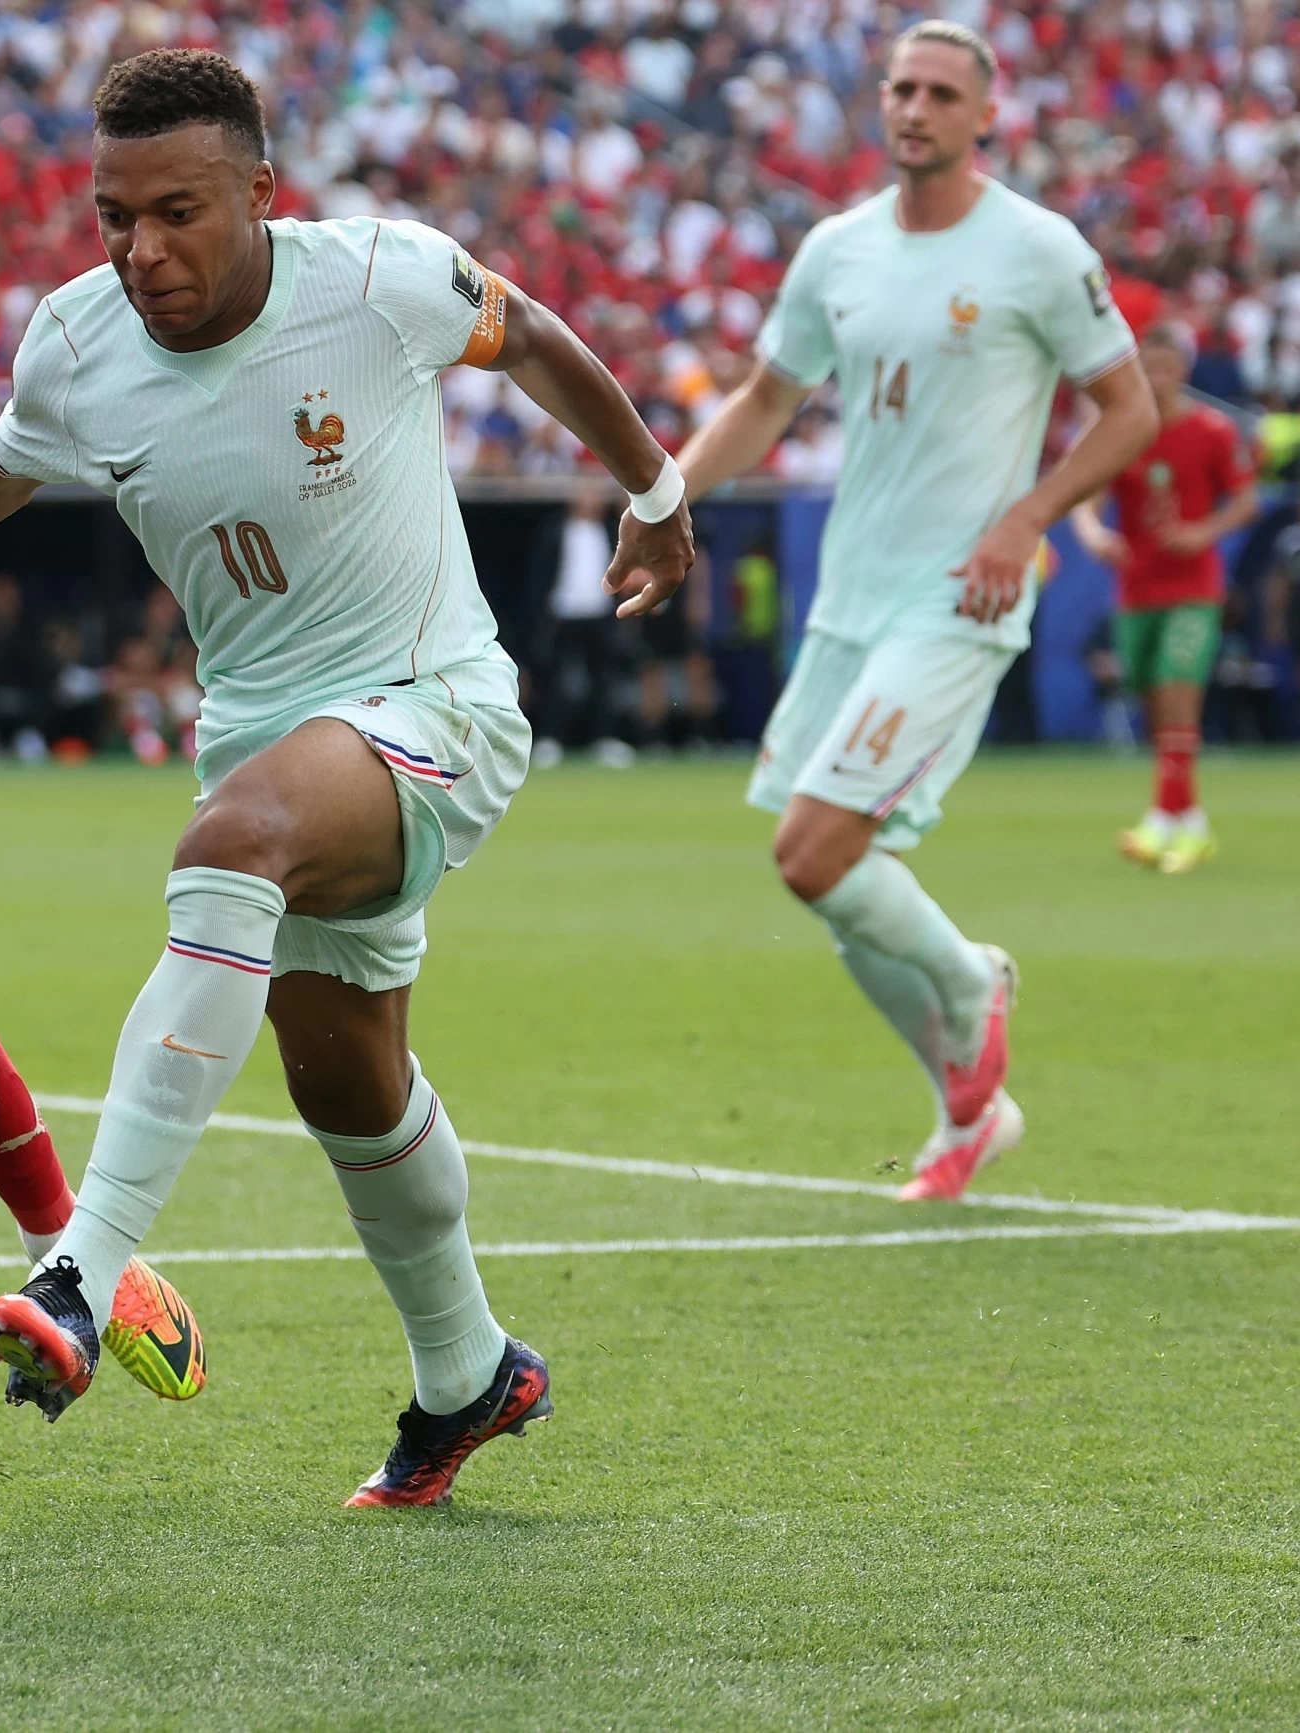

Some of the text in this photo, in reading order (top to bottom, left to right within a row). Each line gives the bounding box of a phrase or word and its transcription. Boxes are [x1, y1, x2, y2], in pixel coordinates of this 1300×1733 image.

[870, 356, 910, 424] 14
[298, 479, 357, 501] 09 JUILLET 2026
[331, 470, 354, 484] MAROC
[209, 521, 289, 600] 10
[844, 697, 907, 766] 14
